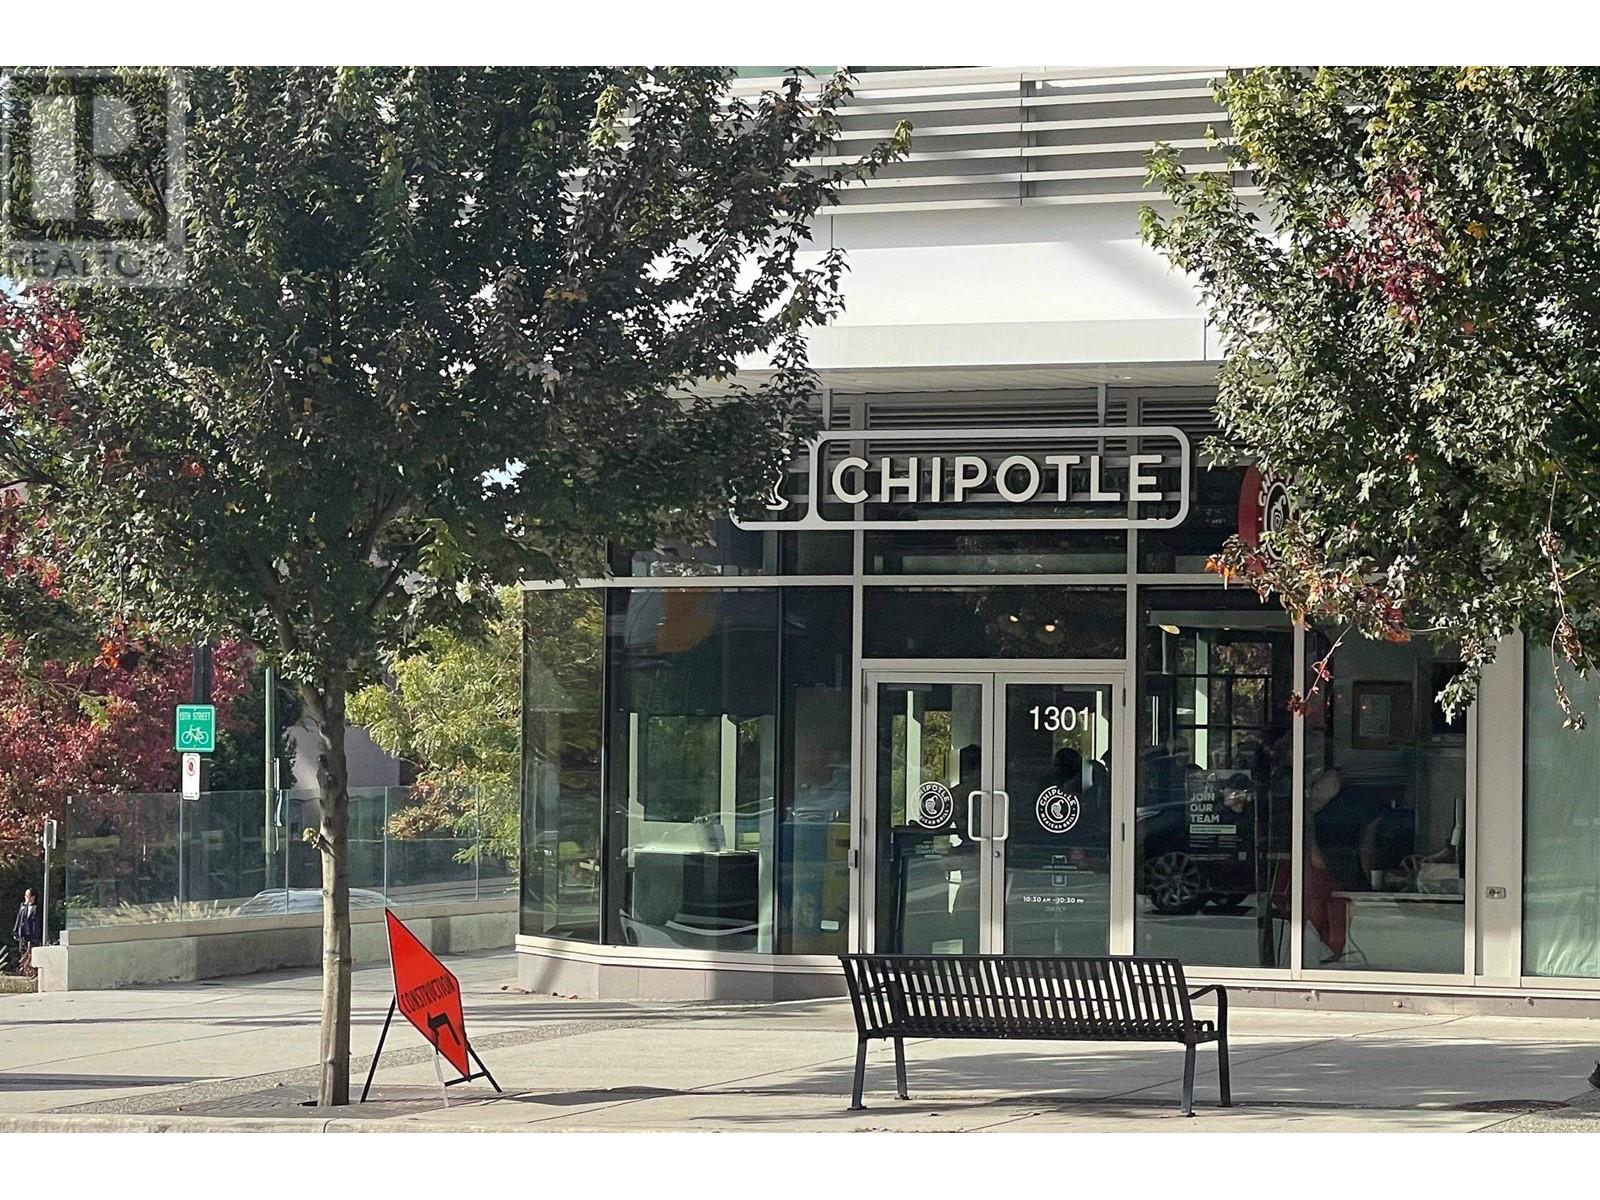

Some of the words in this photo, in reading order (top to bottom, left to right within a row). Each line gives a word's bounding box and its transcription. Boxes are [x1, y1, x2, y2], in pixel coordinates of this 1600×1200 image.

[831, 454, 1163, 503] CHIPOTLE
[1029, 705, 1090, 731] 1301
[1190, 792, 1215, 801] JOIN
[1190, 803, 1213, 812] OUR
[1190, 814, 1220, 823] TEAM
[401, 973, 456, 1014] CONSTRUCTION
